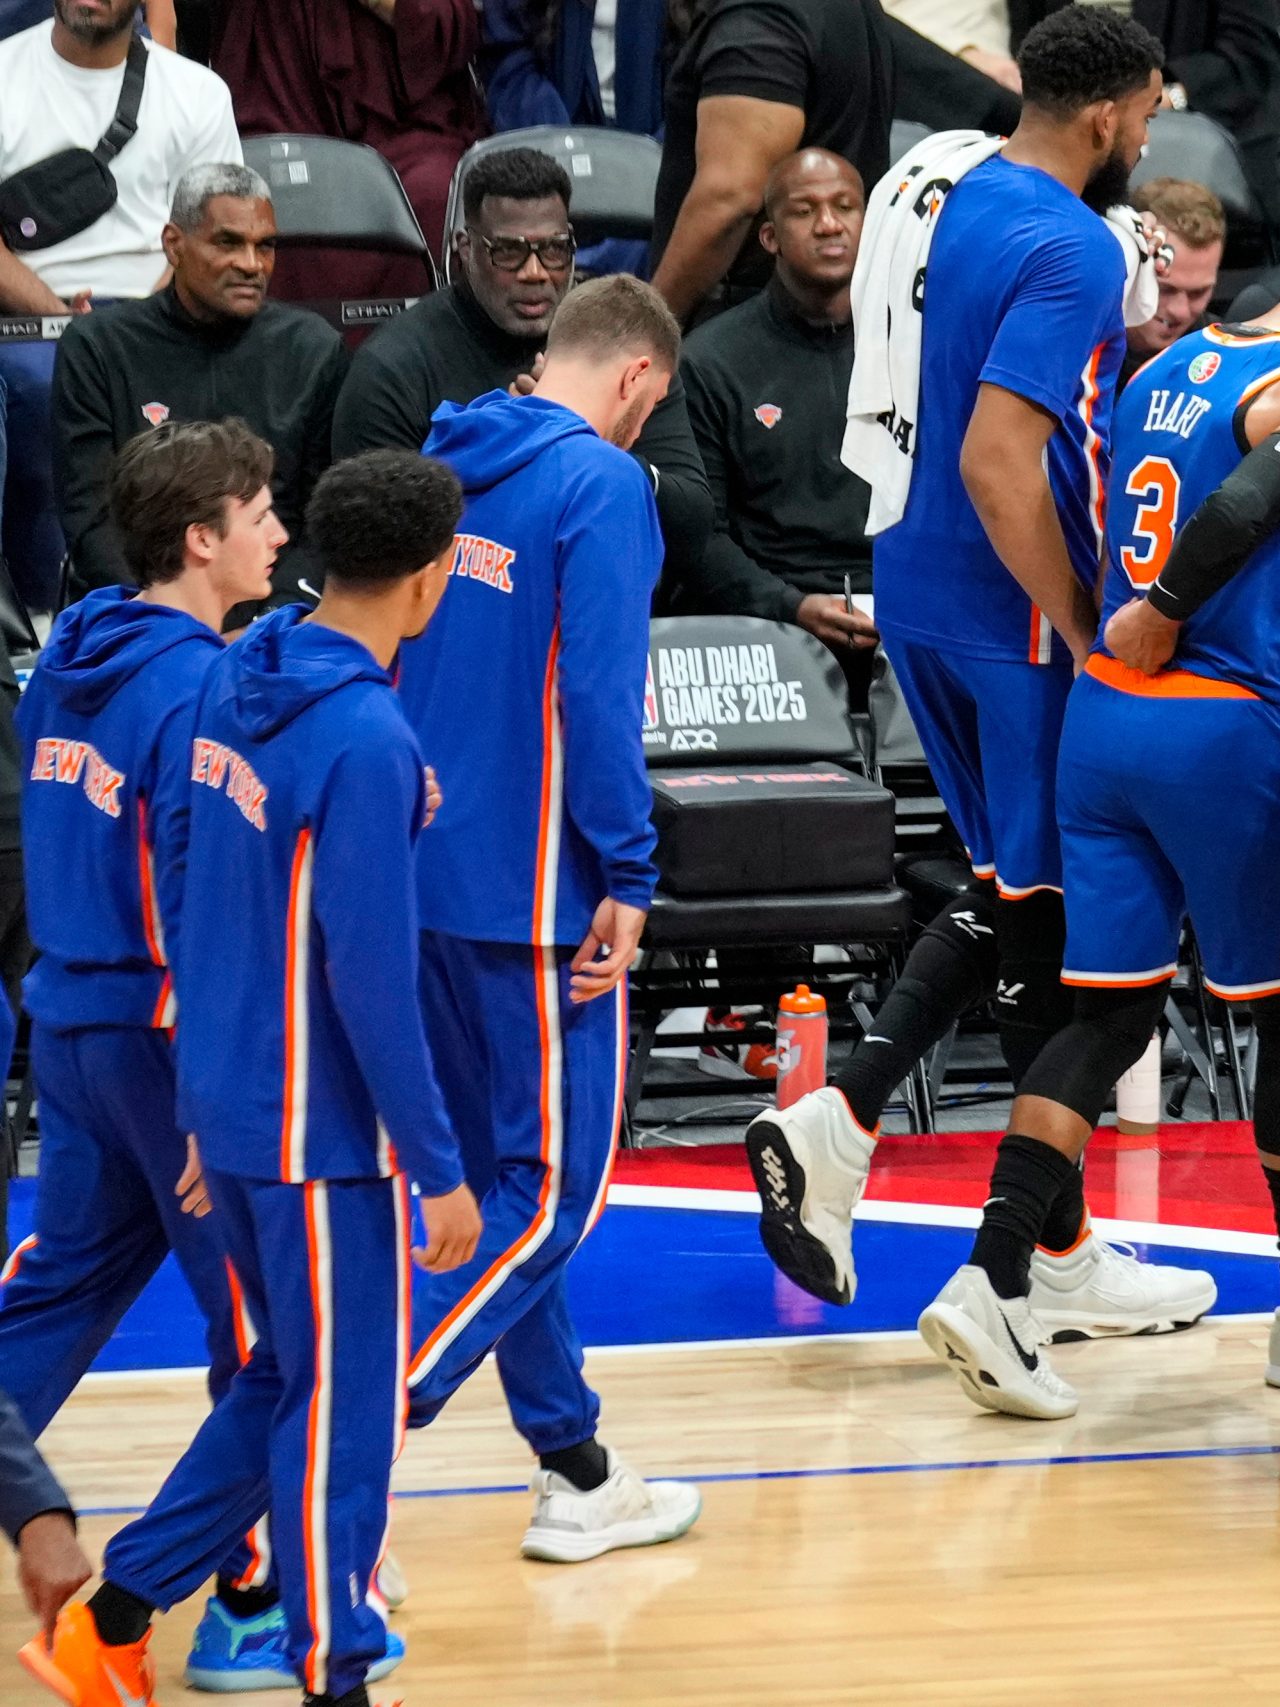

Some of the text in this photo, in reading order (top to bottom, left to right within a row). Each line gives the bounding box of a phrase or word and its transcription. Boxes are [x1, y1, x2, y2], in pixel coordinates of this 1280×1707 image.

[1143, 390, 1212, 440] HART
[1119, 454, 1182, 591] 3
[456, 534, 517, 594] YORK
[658, 643, 778, 688] ABU DHABI
[662, 680, 807, 727] GAMES 2025
[30, 737, 89, 784] EW
[191, 737, 232, 789] EW
[670, 728, 718, 751] ADQ
